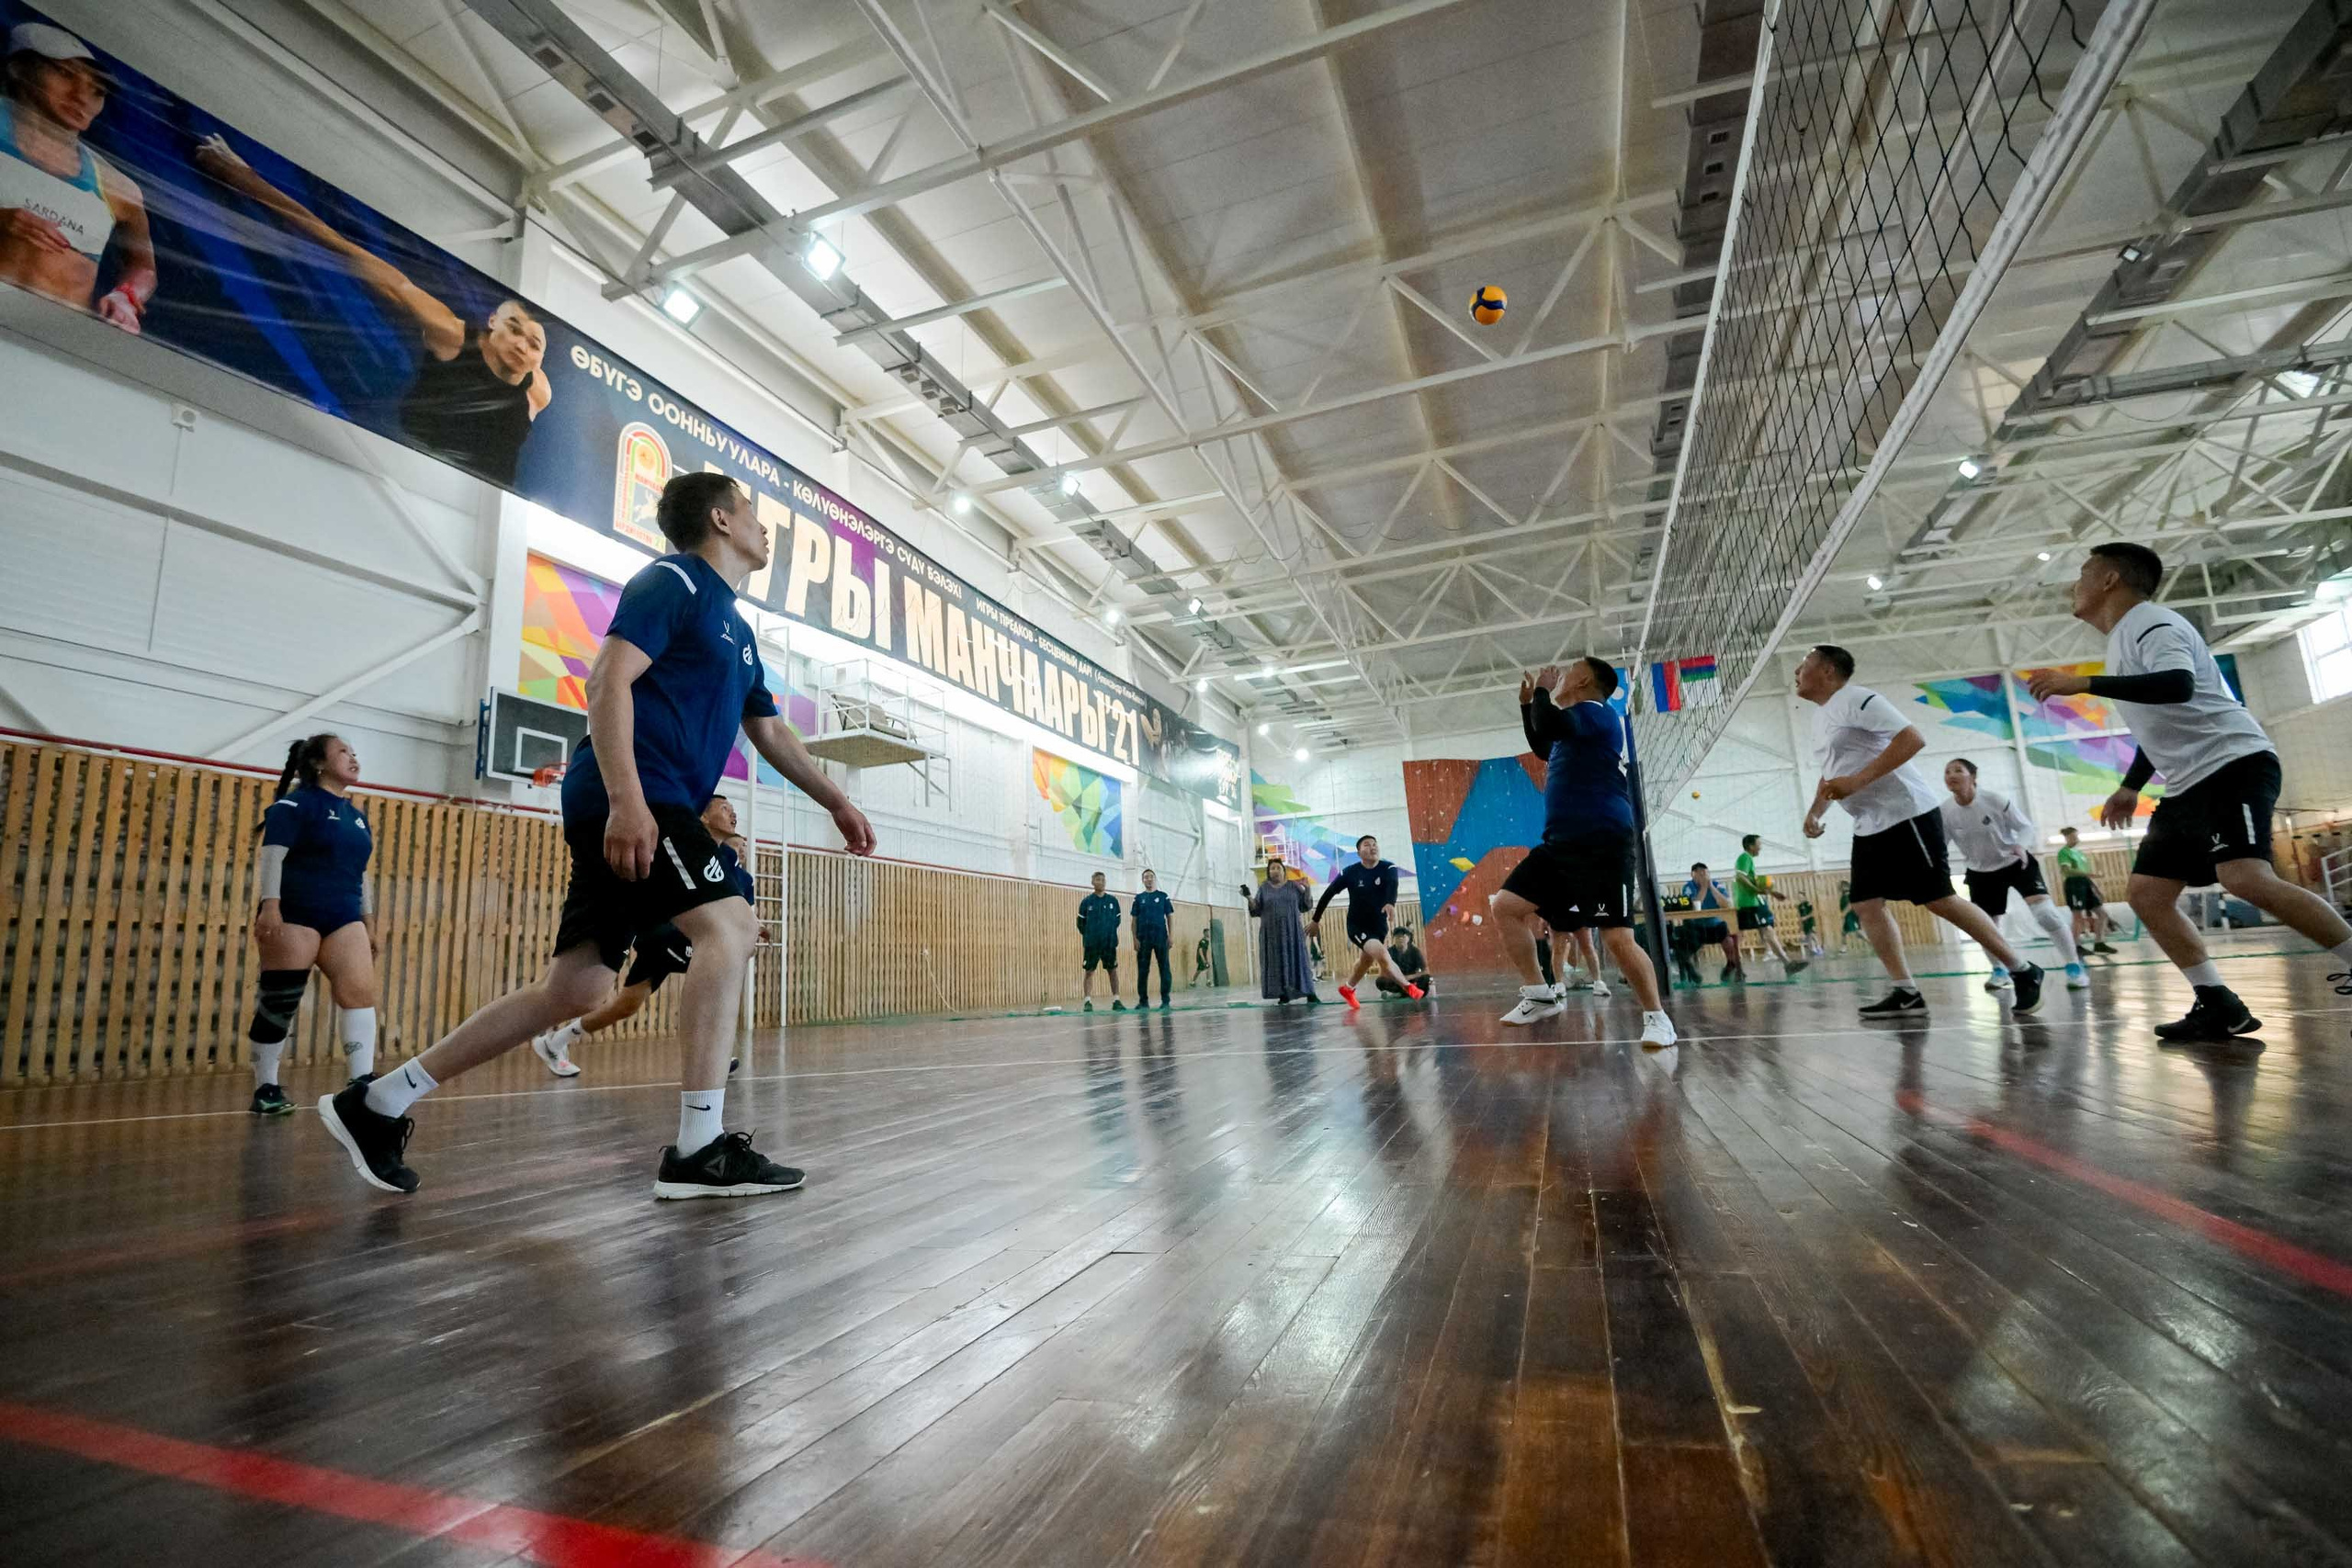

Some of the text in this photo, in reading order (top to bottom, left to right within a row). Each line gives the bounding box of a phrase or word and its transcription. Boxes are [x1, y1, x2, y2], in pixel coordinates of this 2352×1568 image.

[24, 197, 85, 236] SARDANA
[704, 460, 892, 651] ГРЫ
[999, 611, 1035, 644] ПРЕДКОВ
